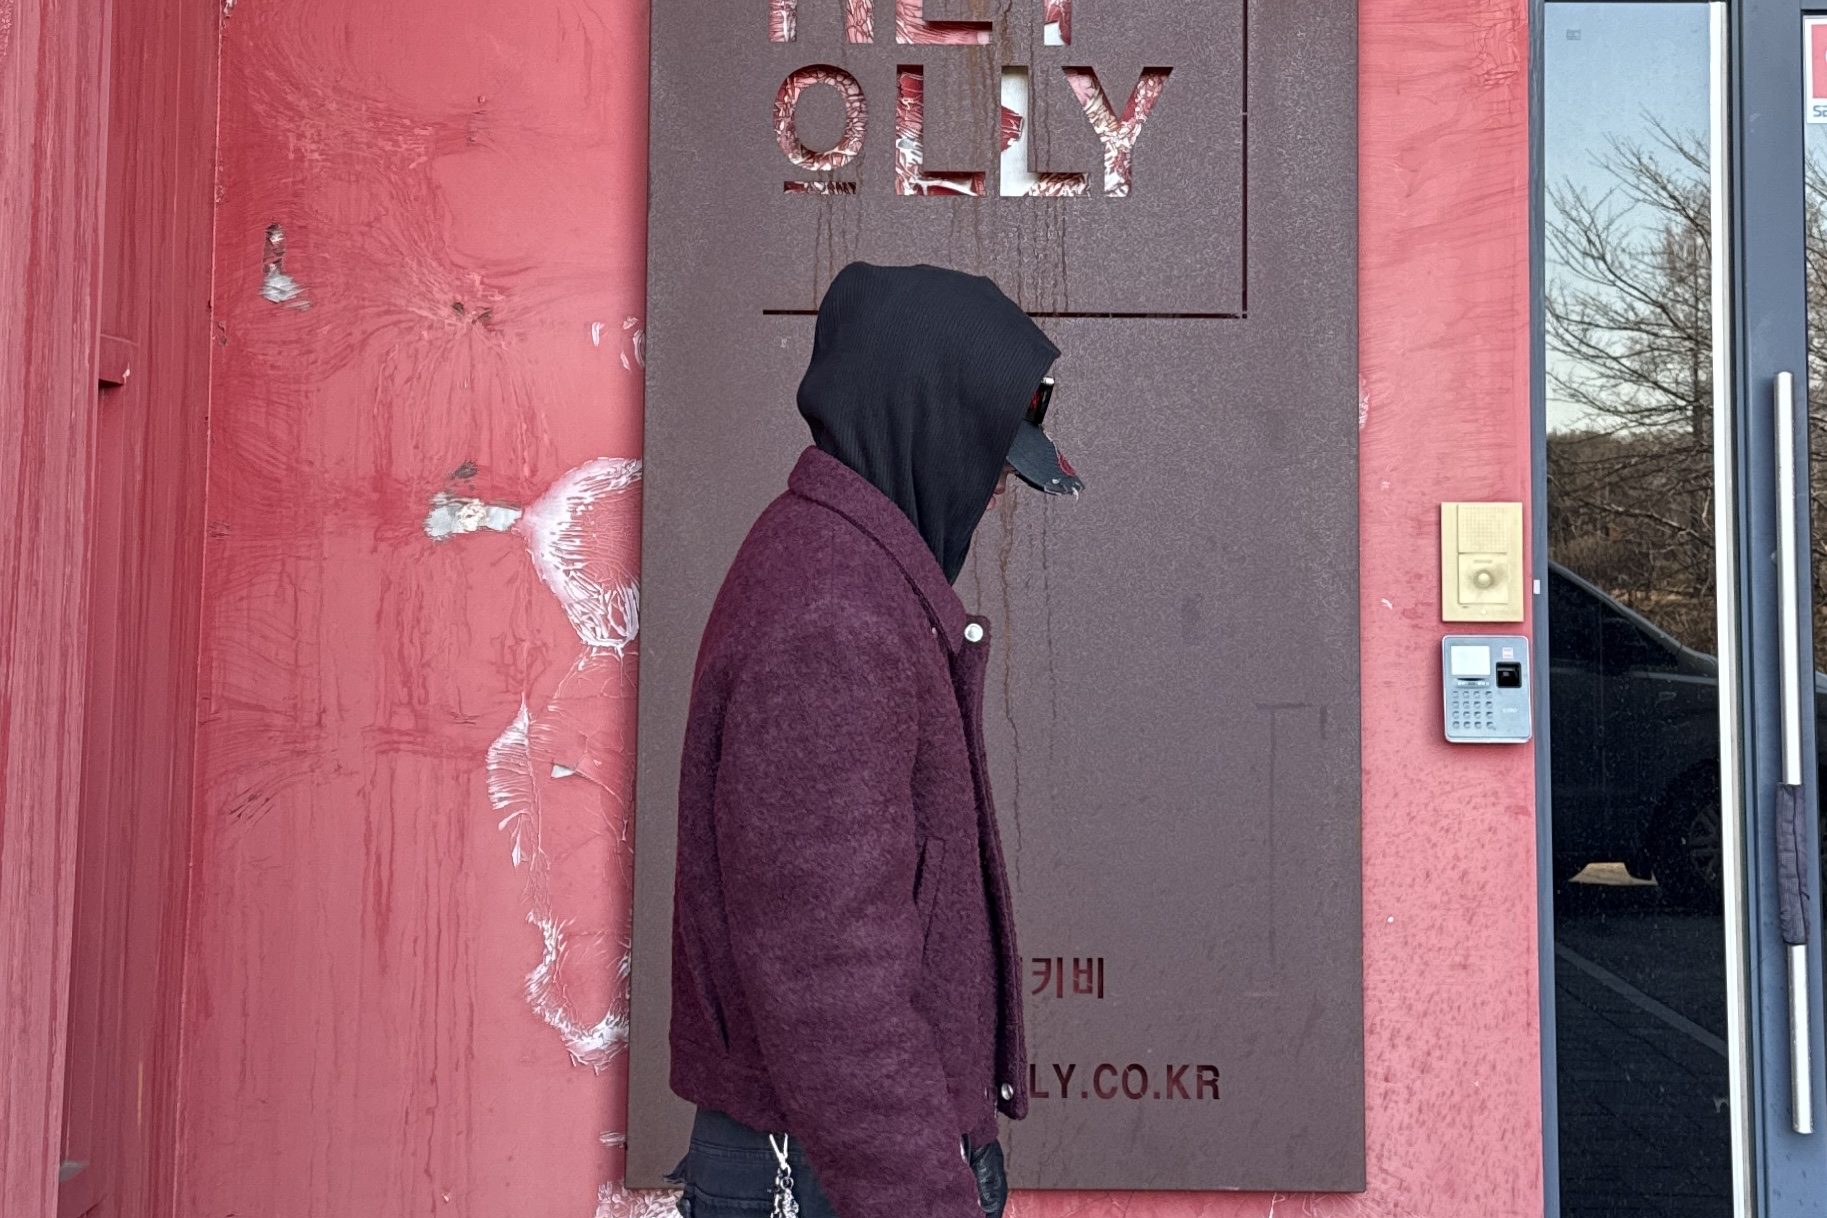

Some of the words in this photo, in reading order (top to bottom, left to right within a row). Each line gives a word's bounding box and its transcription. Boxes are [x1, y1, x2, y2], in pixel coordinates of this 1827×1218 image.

[773, 64, 1173, 197] OLLY
[1020, 957, 1104, 999] 키비
[1029, 1063, 1220, 1100] LY.CO.KR
